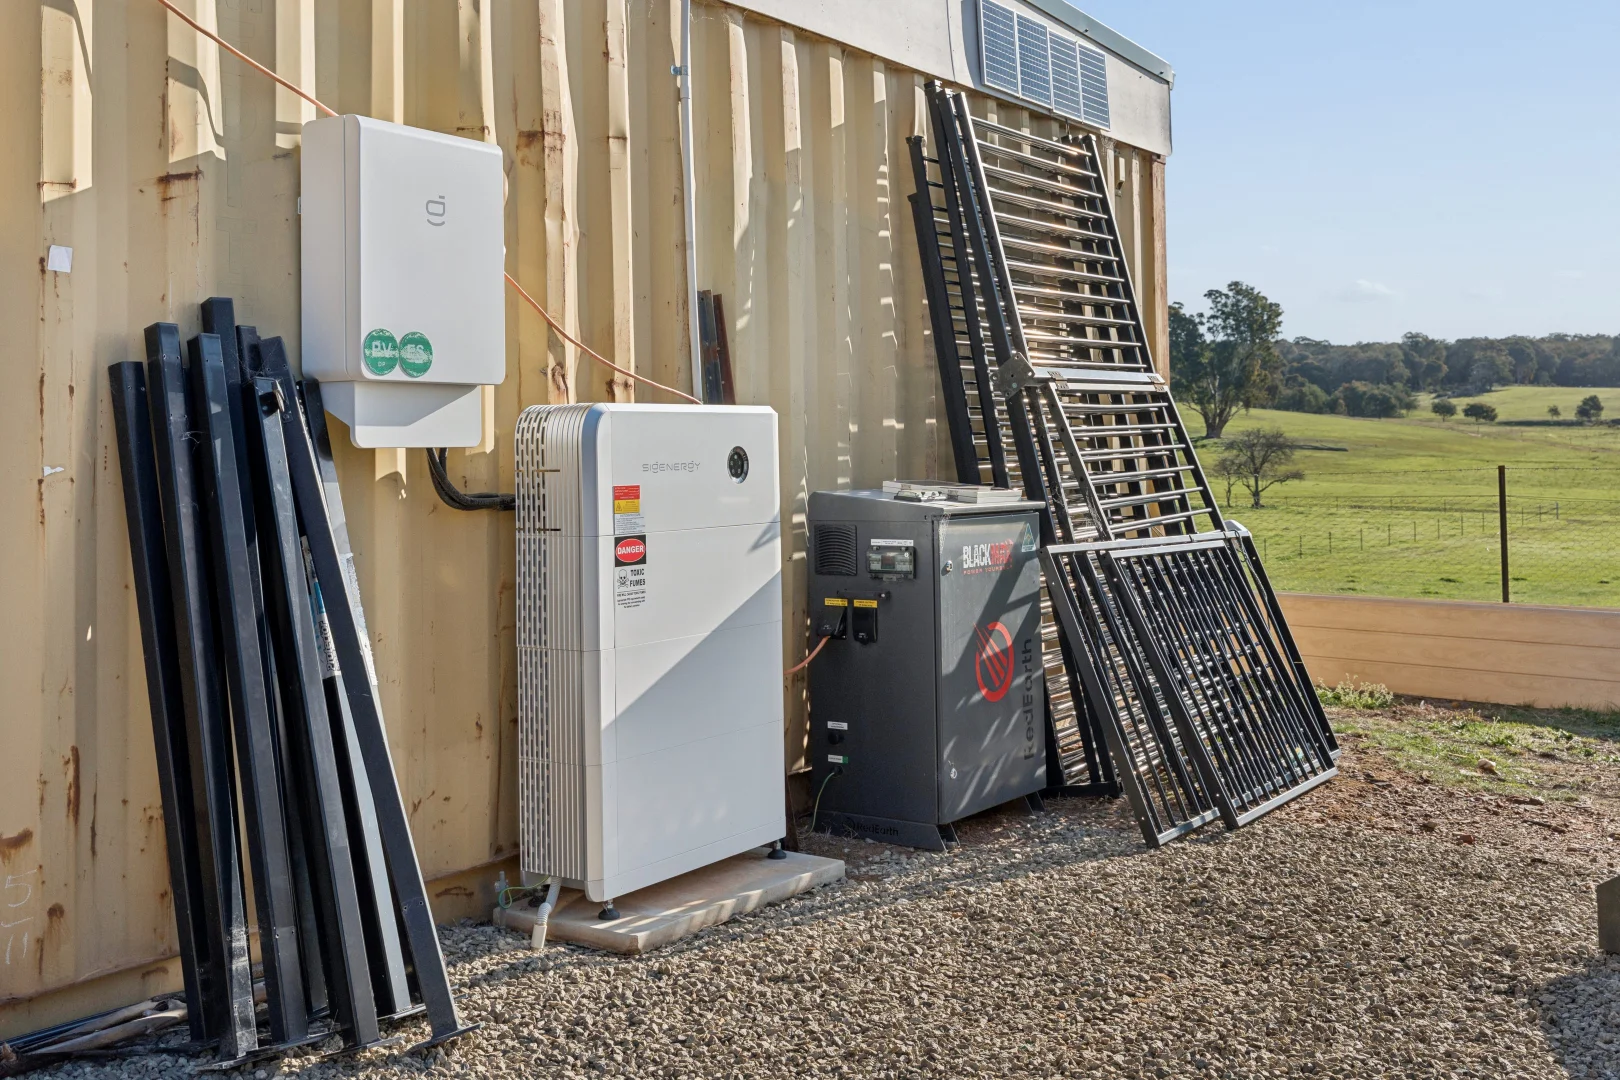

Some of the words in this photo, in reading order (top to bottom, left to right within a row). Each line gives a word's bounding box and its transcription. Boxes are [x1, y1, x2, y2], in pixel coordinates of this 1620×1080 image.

[641, 461, 701, 474] SIGENERGY
[617, 545, 644, 555] DANGER
[630, 568, 645, 577] TOXIC
[629, 579, 646, 587] FUMES
[1021, 638, 1035, 761] RedEarth
[856, 822, 899, 837] RedEarth
